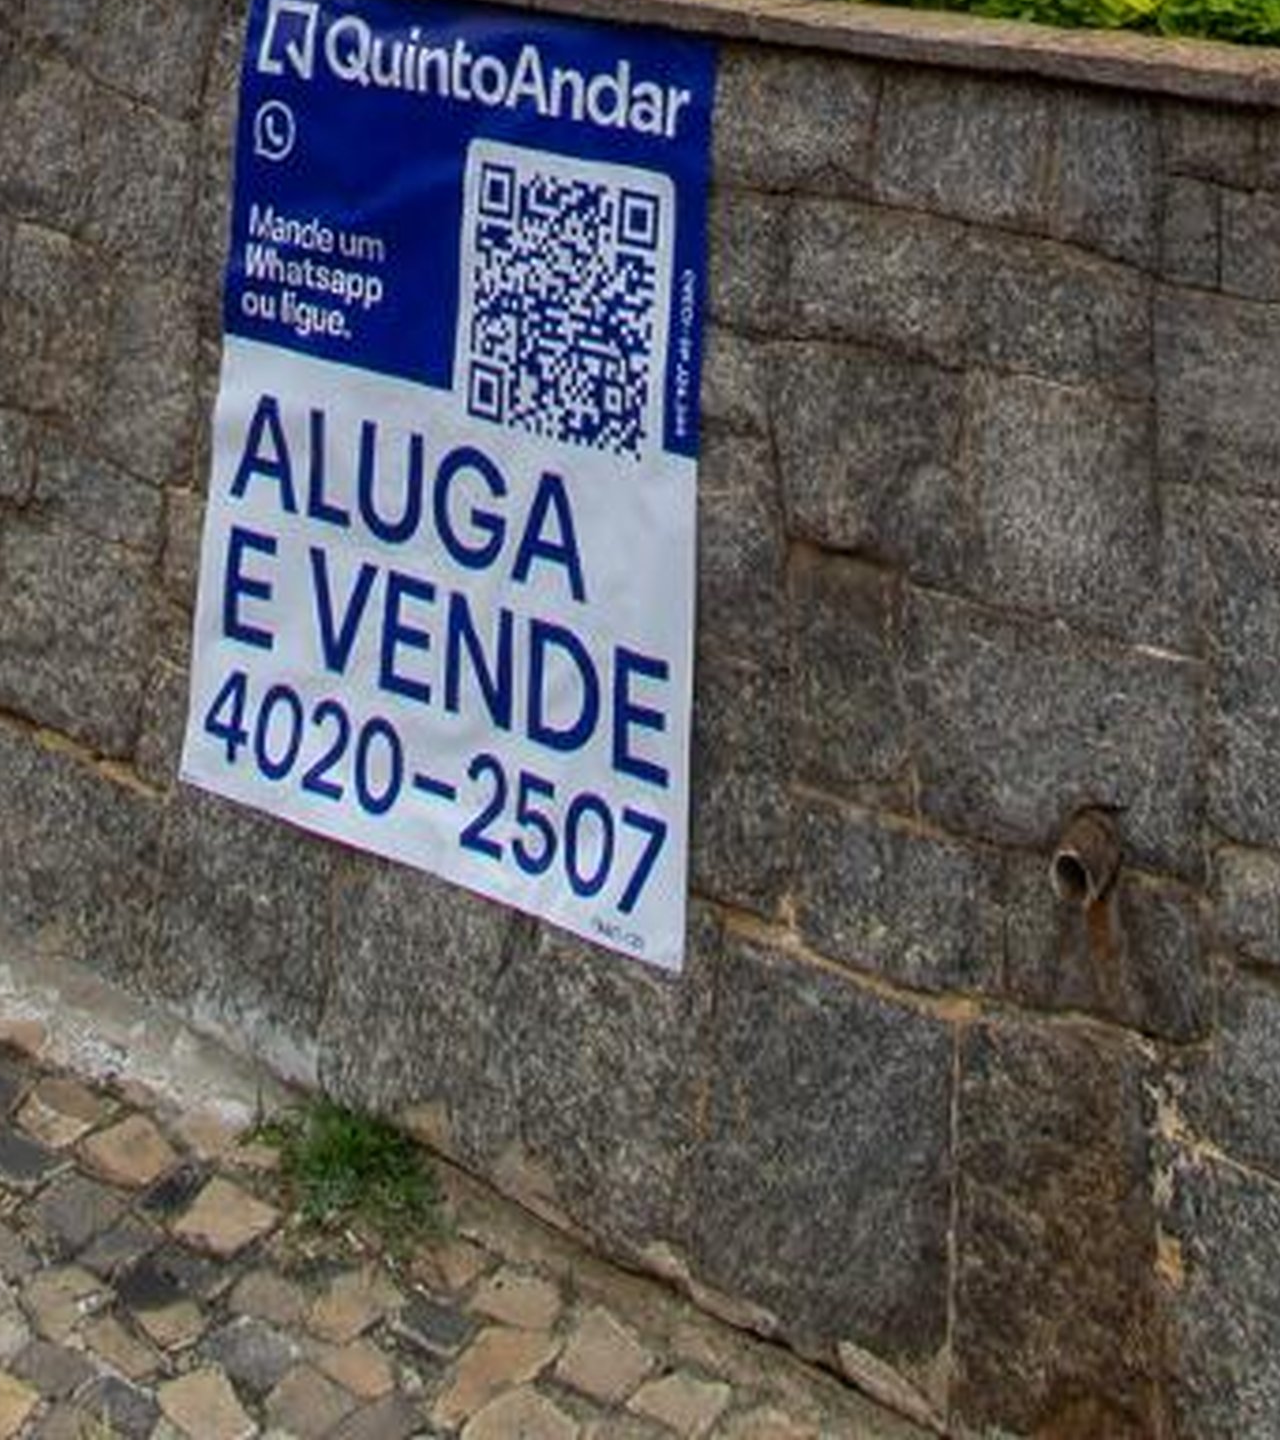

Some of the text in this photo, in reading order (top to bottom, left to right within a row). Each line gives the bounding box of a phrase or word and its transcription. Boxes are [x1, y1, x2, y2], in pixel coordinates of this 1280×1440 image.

[324, 14, 692, 138] QuintoAndar
[245, 242, 384, 310] Whatsapp
[248, 203, 386, 262] Mande um
[241, 289, 353, 340] ou ligue.
[229, 393, 587, 604] ALUGA
[222, 526, 670, 790] E VENDE
[203, 669, 668, 915] 4020-2507
